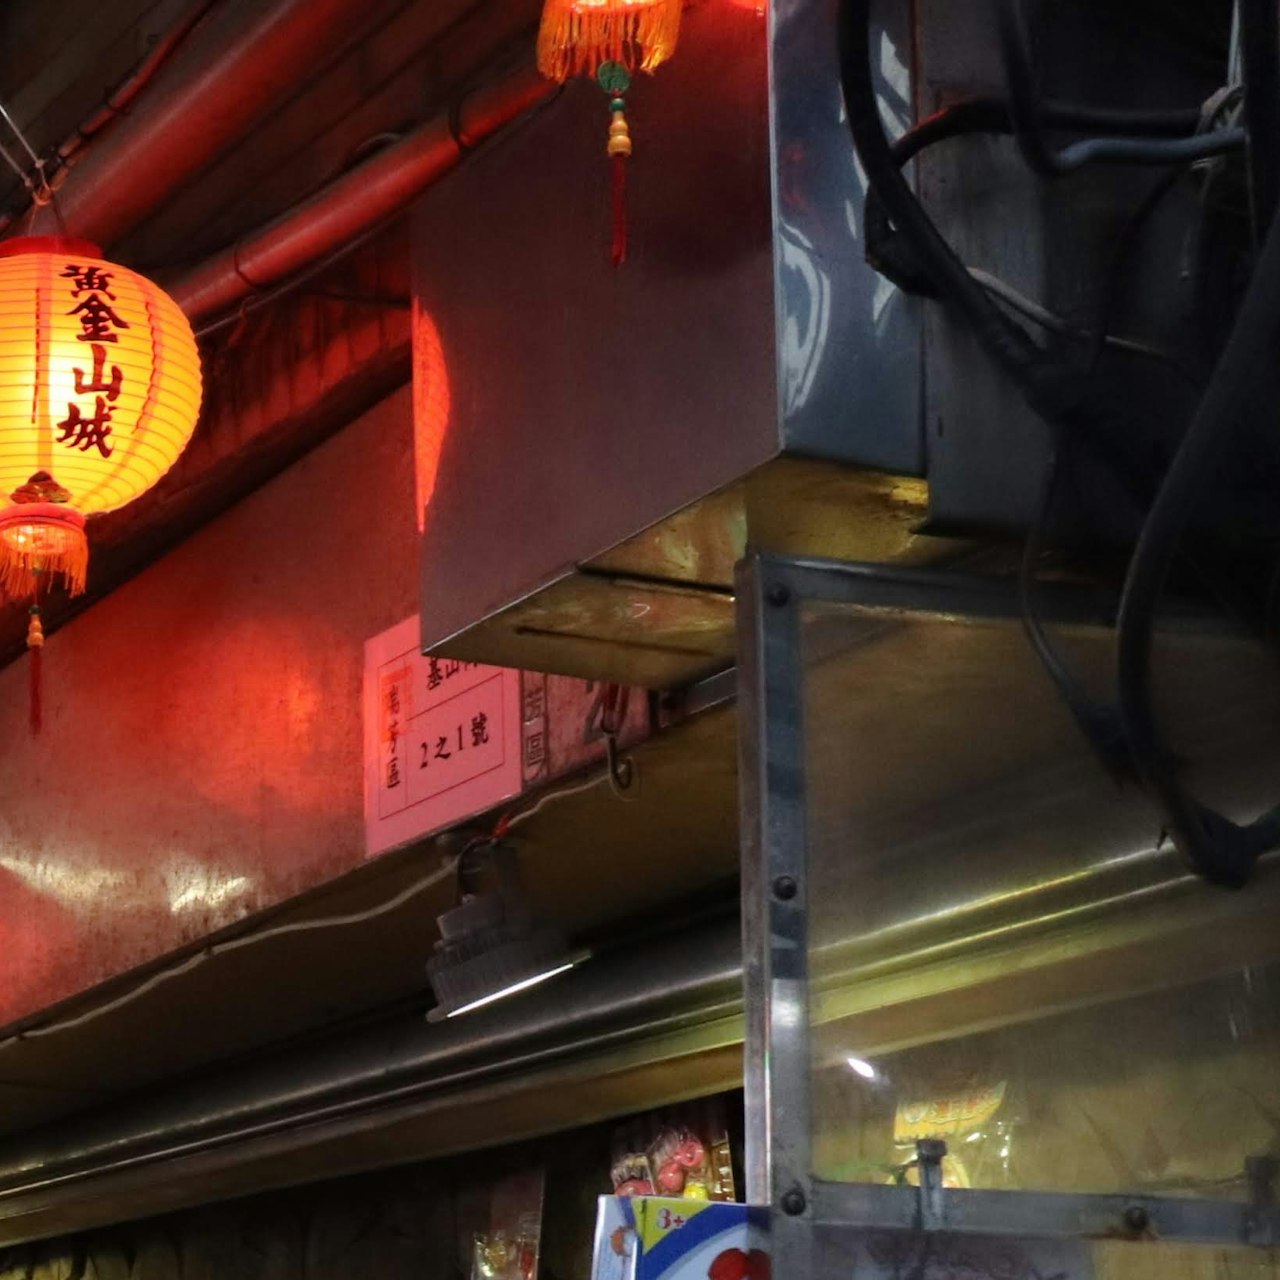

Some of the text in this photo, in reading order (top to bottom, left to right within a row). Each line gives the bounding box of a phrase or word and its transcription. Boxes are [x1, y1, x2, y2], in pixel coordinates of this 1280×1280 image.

[57, 263, 129, 459] 黃金山城
[419, 711, 490, 770] 2之1號
